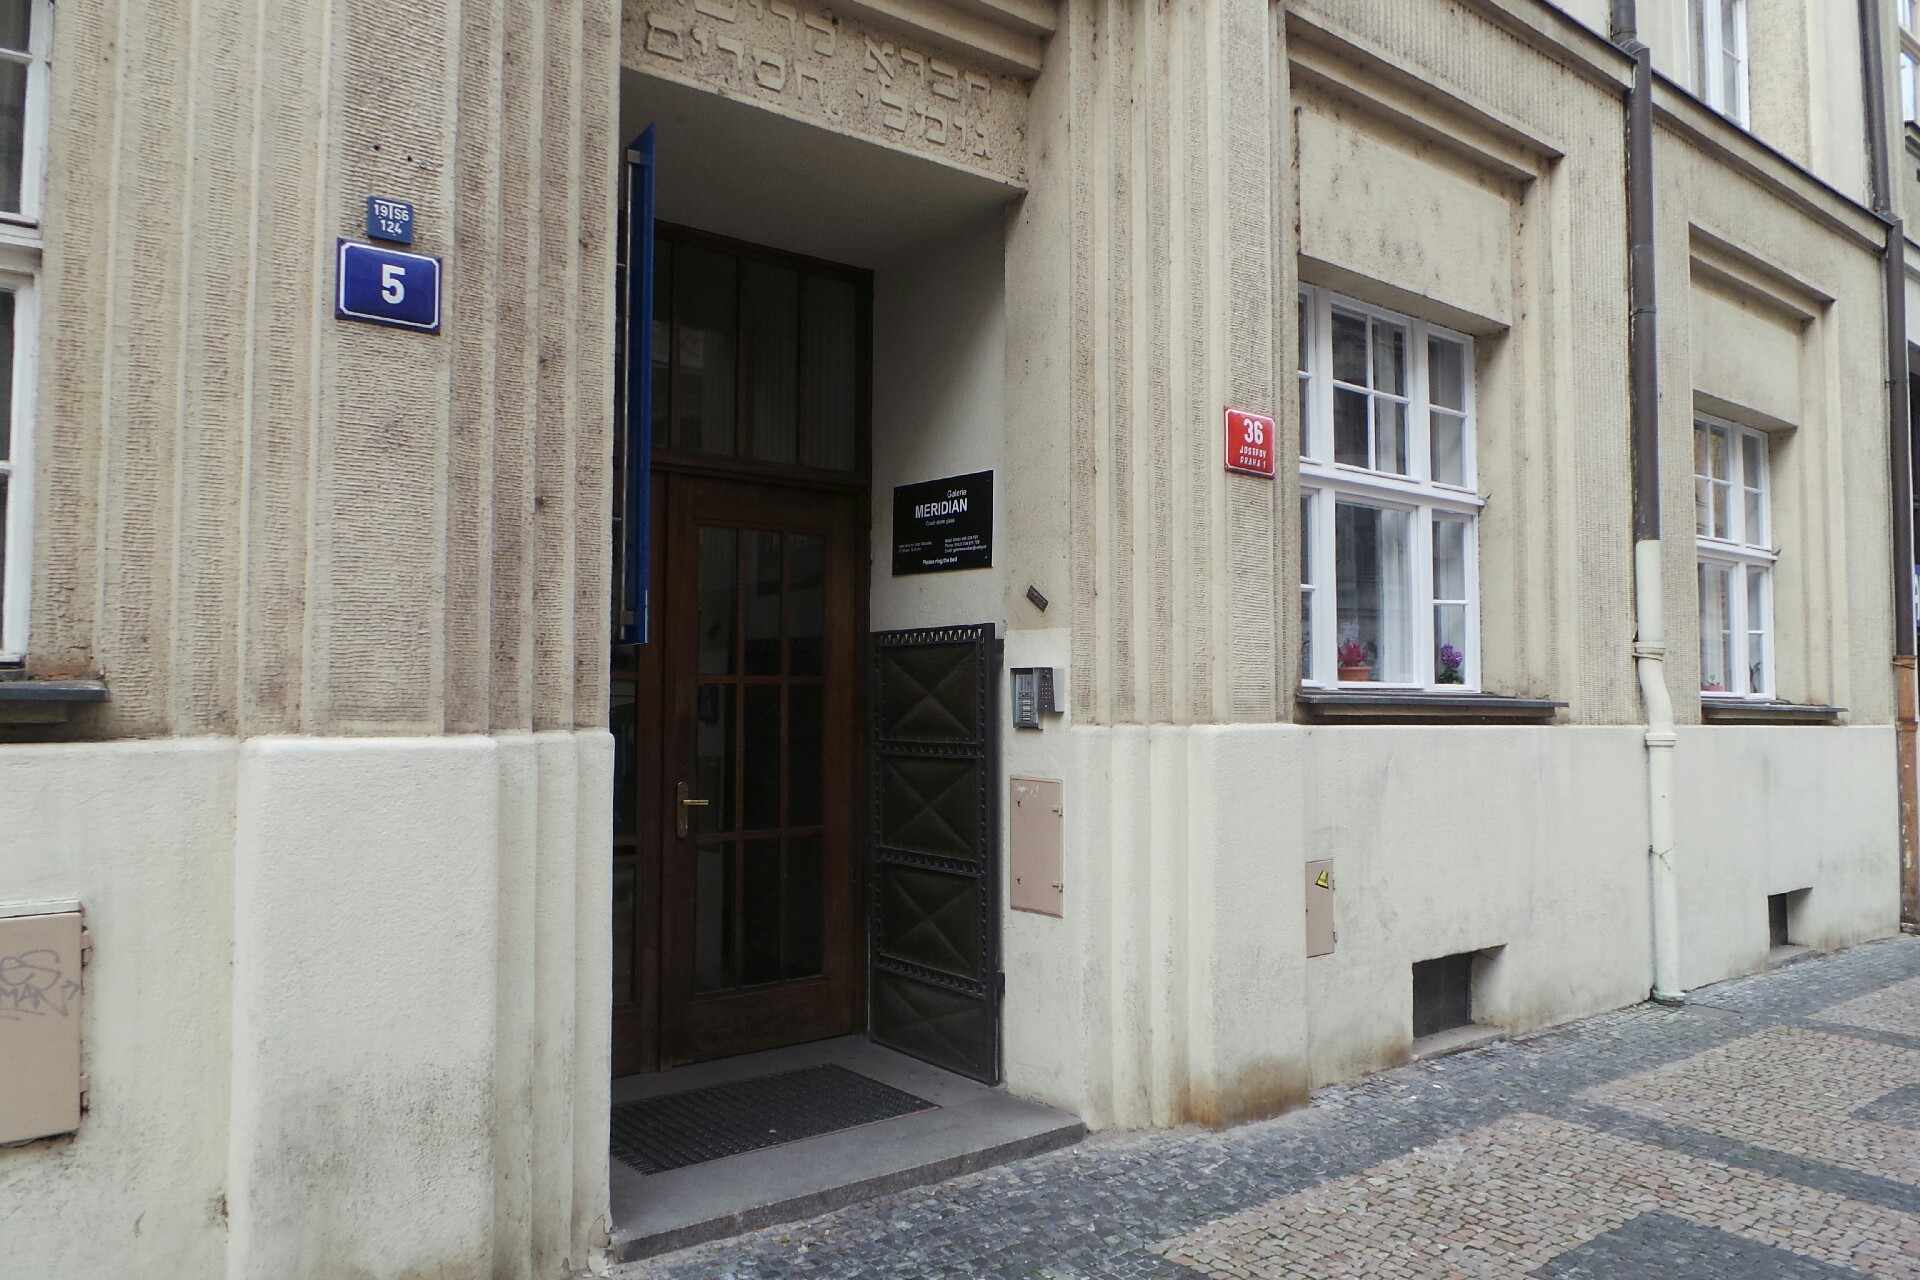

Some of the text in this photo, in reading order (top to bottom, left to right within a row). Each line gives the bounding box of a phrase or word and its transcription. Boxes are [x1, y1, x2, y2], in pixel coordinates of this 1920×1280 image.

[645, 11, 825, 105] חסדים
[862, 33, 992, 113] חברא
[380, 219, 402, 235] 124
[381, 263, 406, 305] 5
[1243, 418, 1264, 445] 36
[1239, 444, 1267, 459] JOSEFOV
[1239, 455, 1261, 468] PRAHA
[915, 498, 968, 519] MERIDIAN
